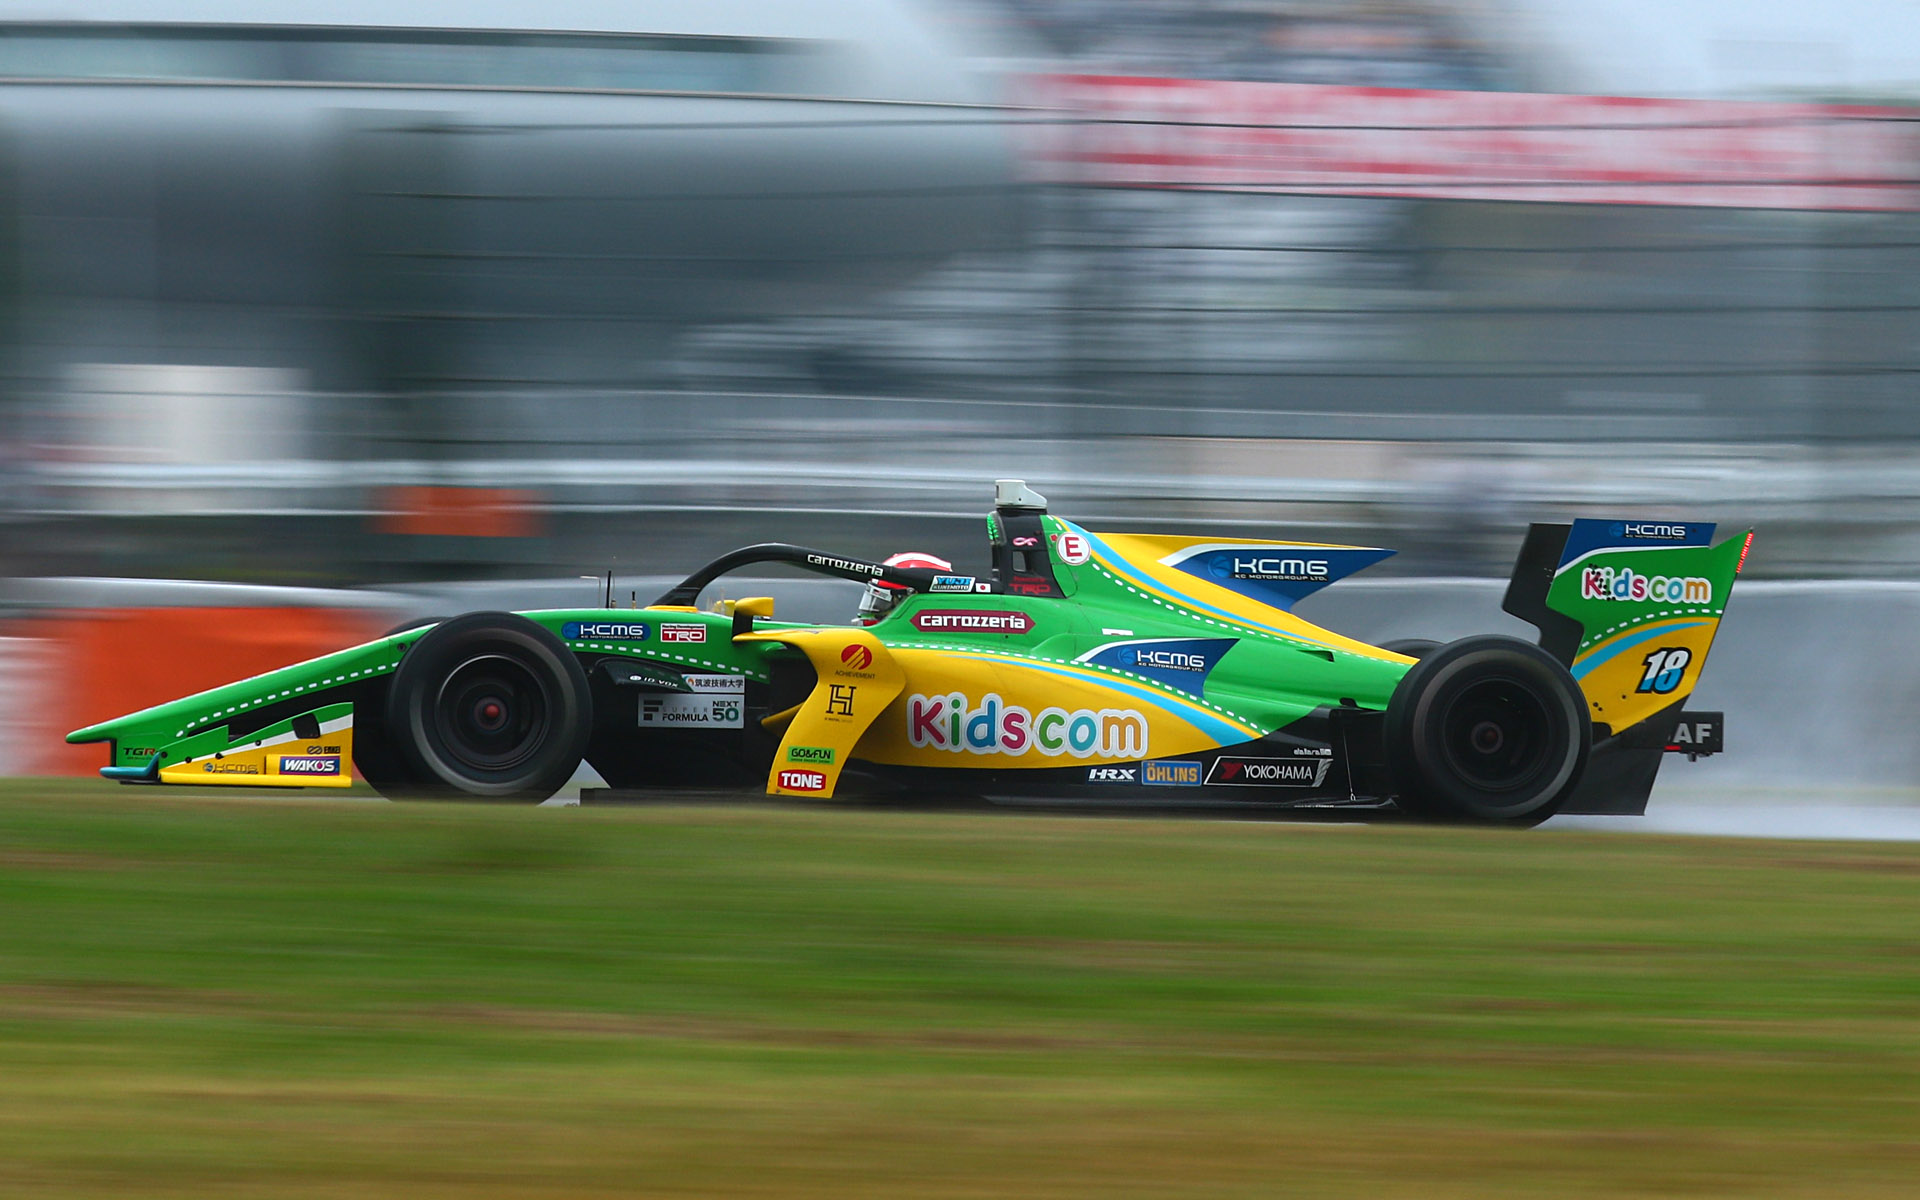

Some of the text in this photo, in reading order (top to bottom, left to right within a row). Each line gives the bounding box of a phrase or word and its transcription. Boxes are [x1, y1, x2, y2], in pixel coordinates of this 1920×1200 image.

[1625, 524, 1686, 536] KCMG
[1064, 536, 1083, 557] E
[807, 554, 884, 576] carrozzeria
[1234, 558, 1328, 575] KCMG
[935, 577, 972, 586] YUJI
[1009, 583, 1051, 595] TRD
[920, 615, 1025, 629] carrozzeria
[580, 625, 643, 635] KCMG
[664, 631, 703, 642] TRD
[1137, 650, 1205, 667] KCMG
[835, 670, 875, 679] ACHIEVEMENT
[1637, 648, 1691, 693] 18
[662, 713, 709, 722] FORMULA
[712, 708, 739, 722] 50
[1667, 723, 1712, 743] AF
[123, 747, 155, 756] TGR
[791, 748, 831, 759] GO&FUN
[1088, 768, 1137, 780] HRX
[1146, 762, 1198, 783] ÖHLINS
[1243, 764, 1313, 780] YOKOHAMA
[781, 772, 823, 788] TONE
